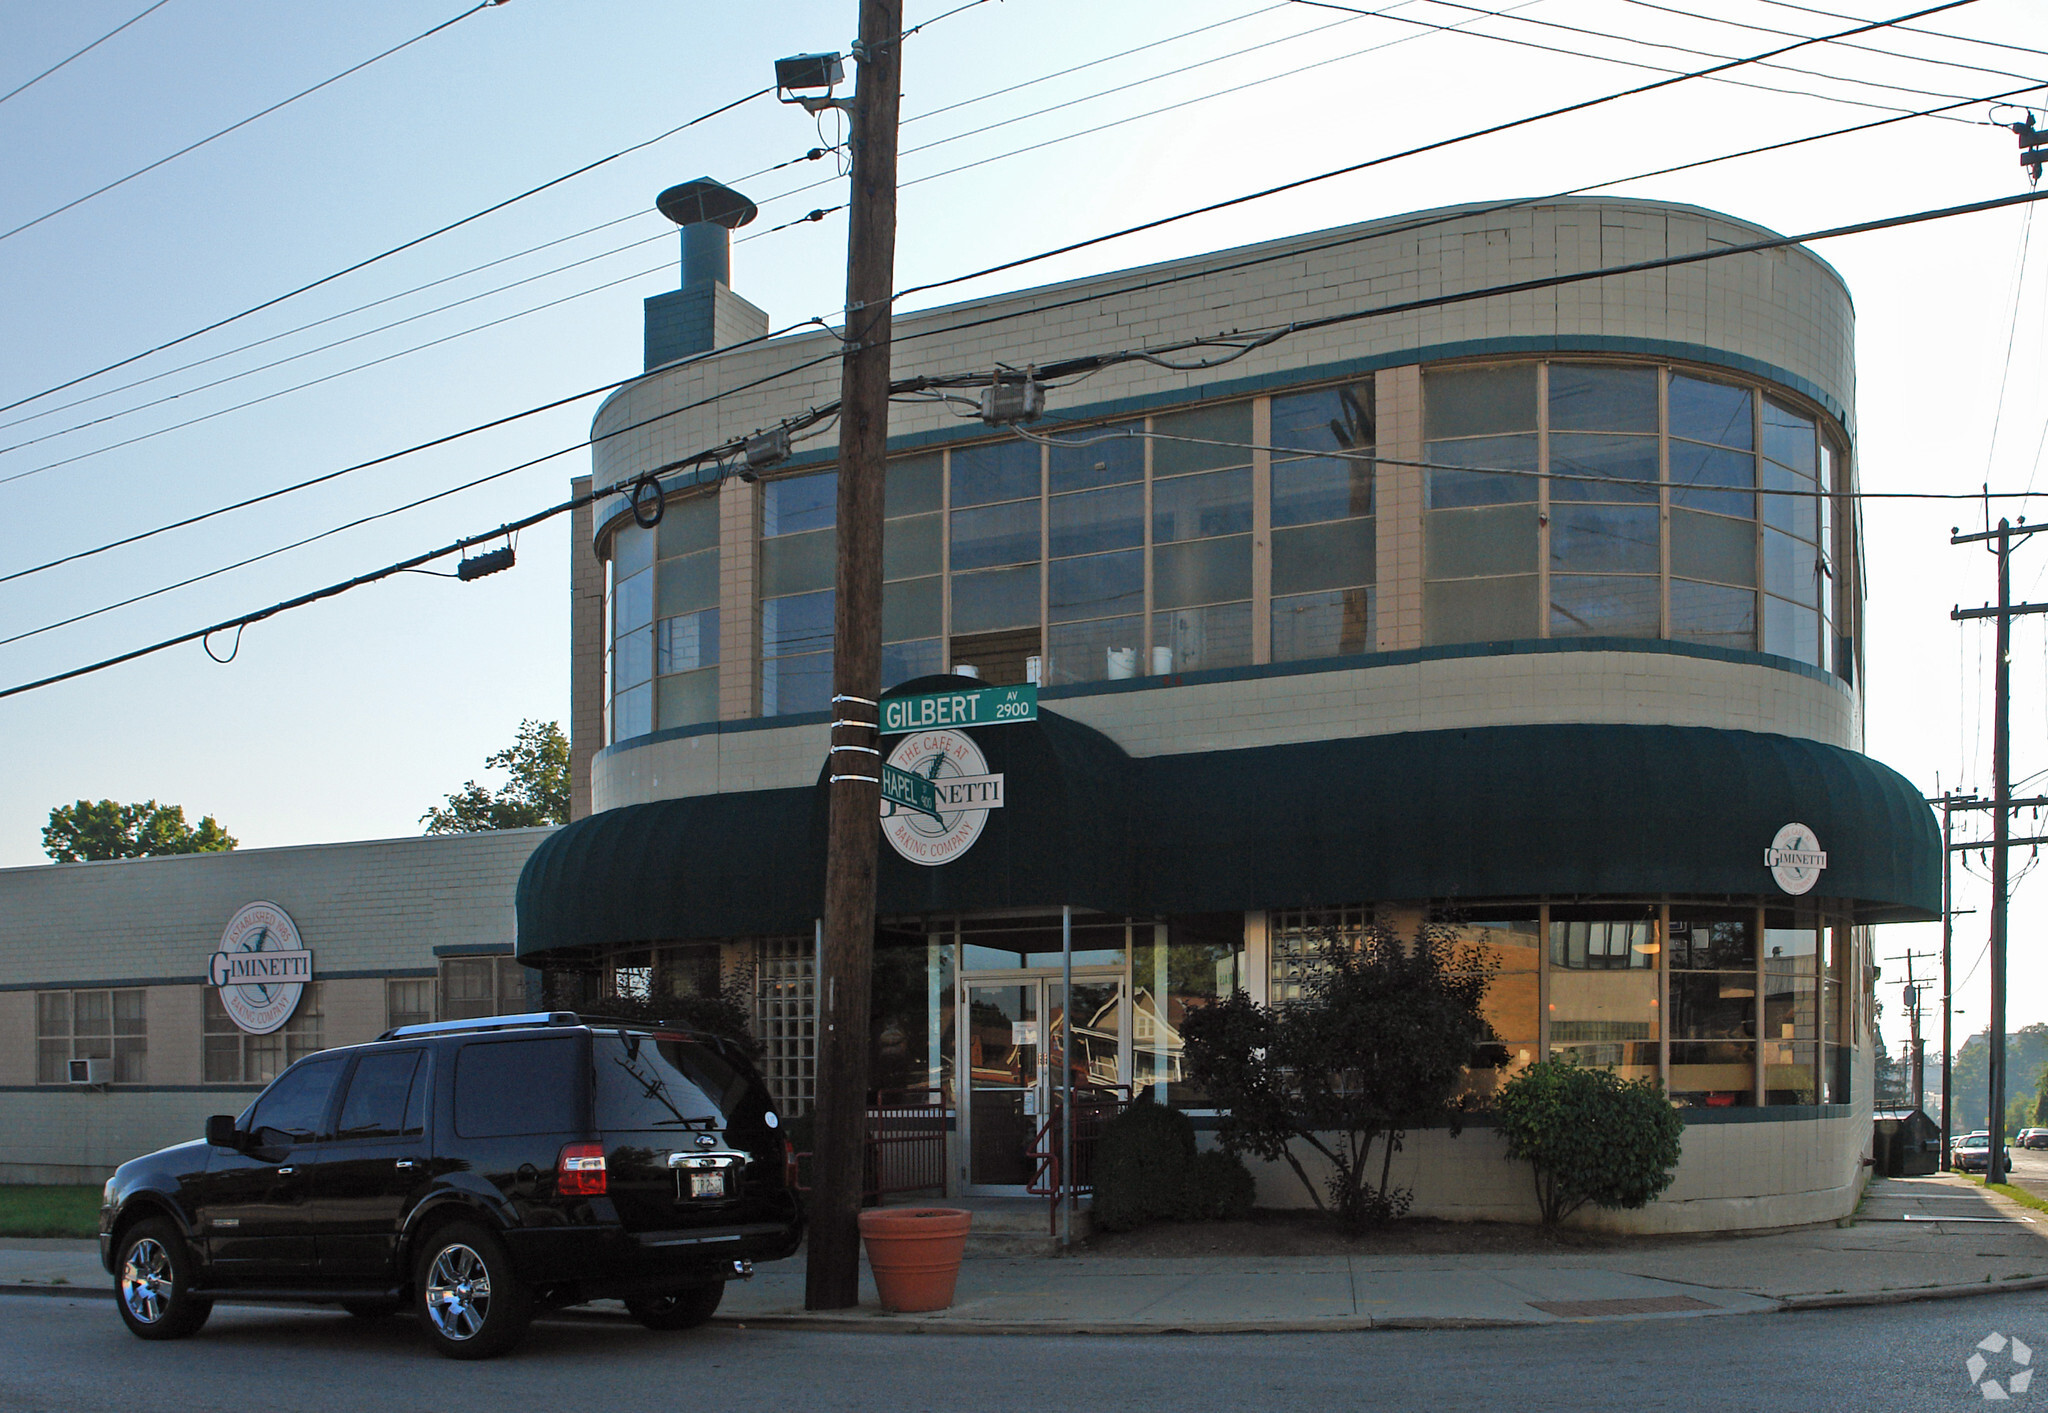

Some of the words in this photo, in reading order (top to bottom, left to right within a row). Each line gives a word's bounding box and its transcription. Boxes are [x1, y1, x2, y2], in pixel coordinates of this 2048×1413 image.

[886, 694, 981, 728] GILBERT
[1006, 691, 1018, 701] AV
[996, 702, 1029, 718] 2900
[899, 742, 921, 765] THE
[923, 736, 953, 751] CAFE
[955, 745, 969, 760] AT
[883, 769, 917, 804] HAPEL
[895, 825, 926, 856] BAKING
[930, 822, 973, 857] COMPANY
[1767, 848, 1825, 868] GIMINETTI
[229, 911, 276, 944] ESTABLISHED
[277, 921, 291, 942] 1985
[209, 951, 309, 987] GIMINETTI
[230, 995, 255, 1023] BAKING
[257, 994, 290, 1024] COMPANY
